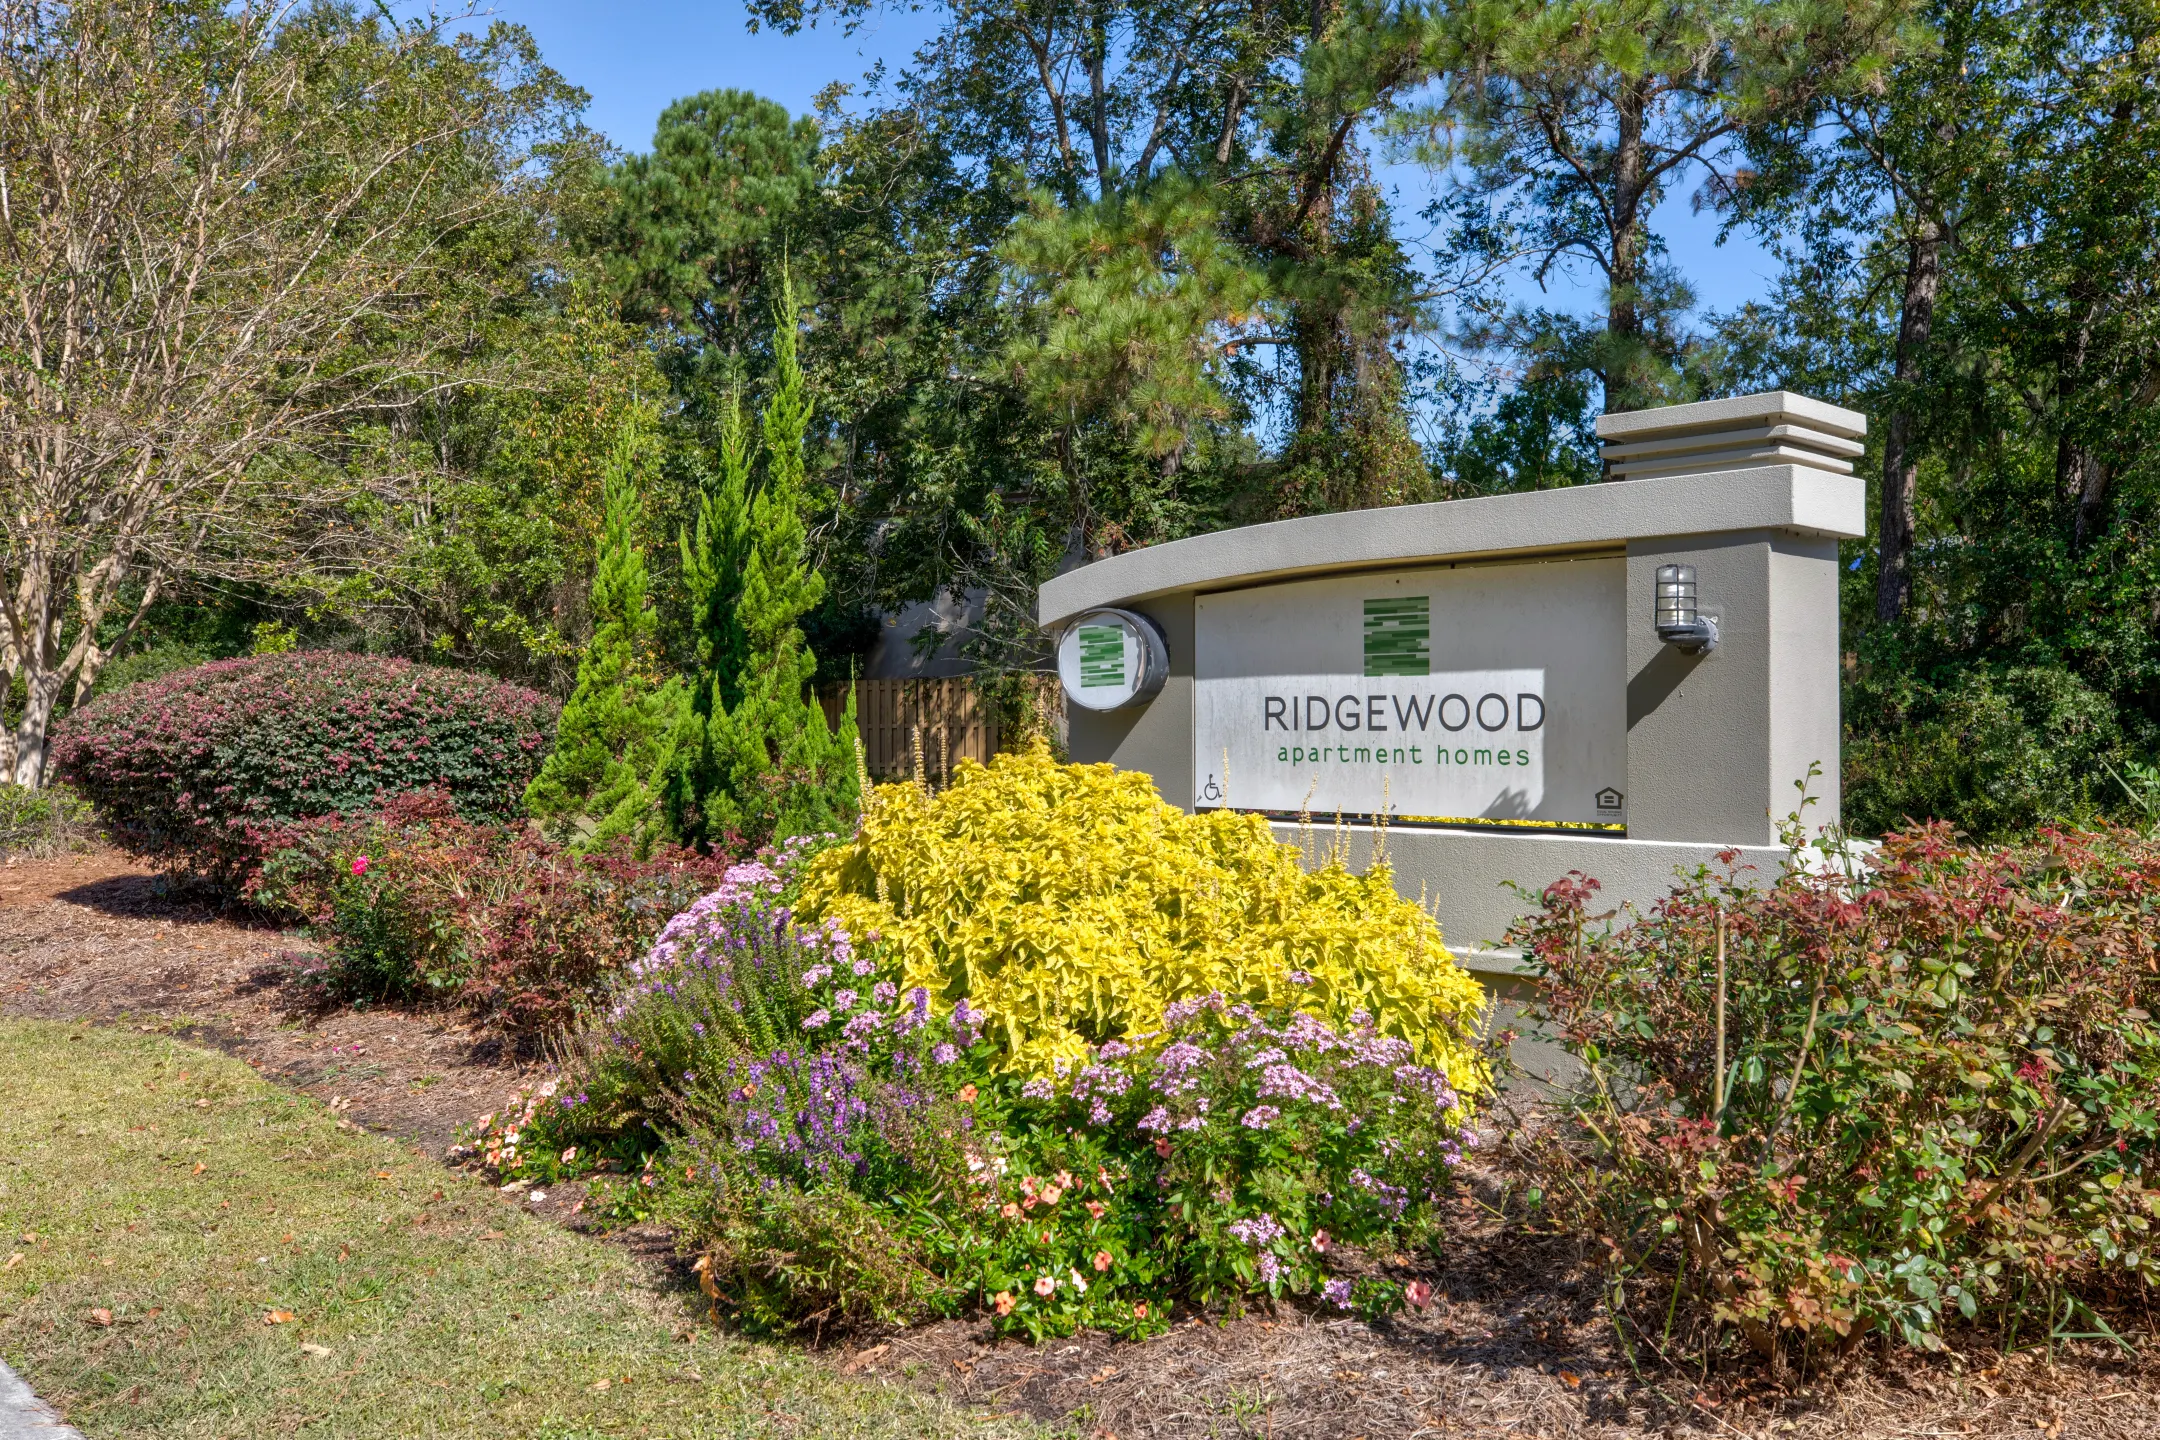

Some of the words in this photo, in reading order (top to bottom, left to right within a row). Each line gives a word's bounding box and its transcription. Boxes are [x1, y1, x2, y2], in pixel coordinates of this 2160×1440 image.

[1264, 693, 1546, 732] RIDGEWOOD
[1277, 745, 1423, 767] apartment
[1437, 745, 1530, 766] homes
